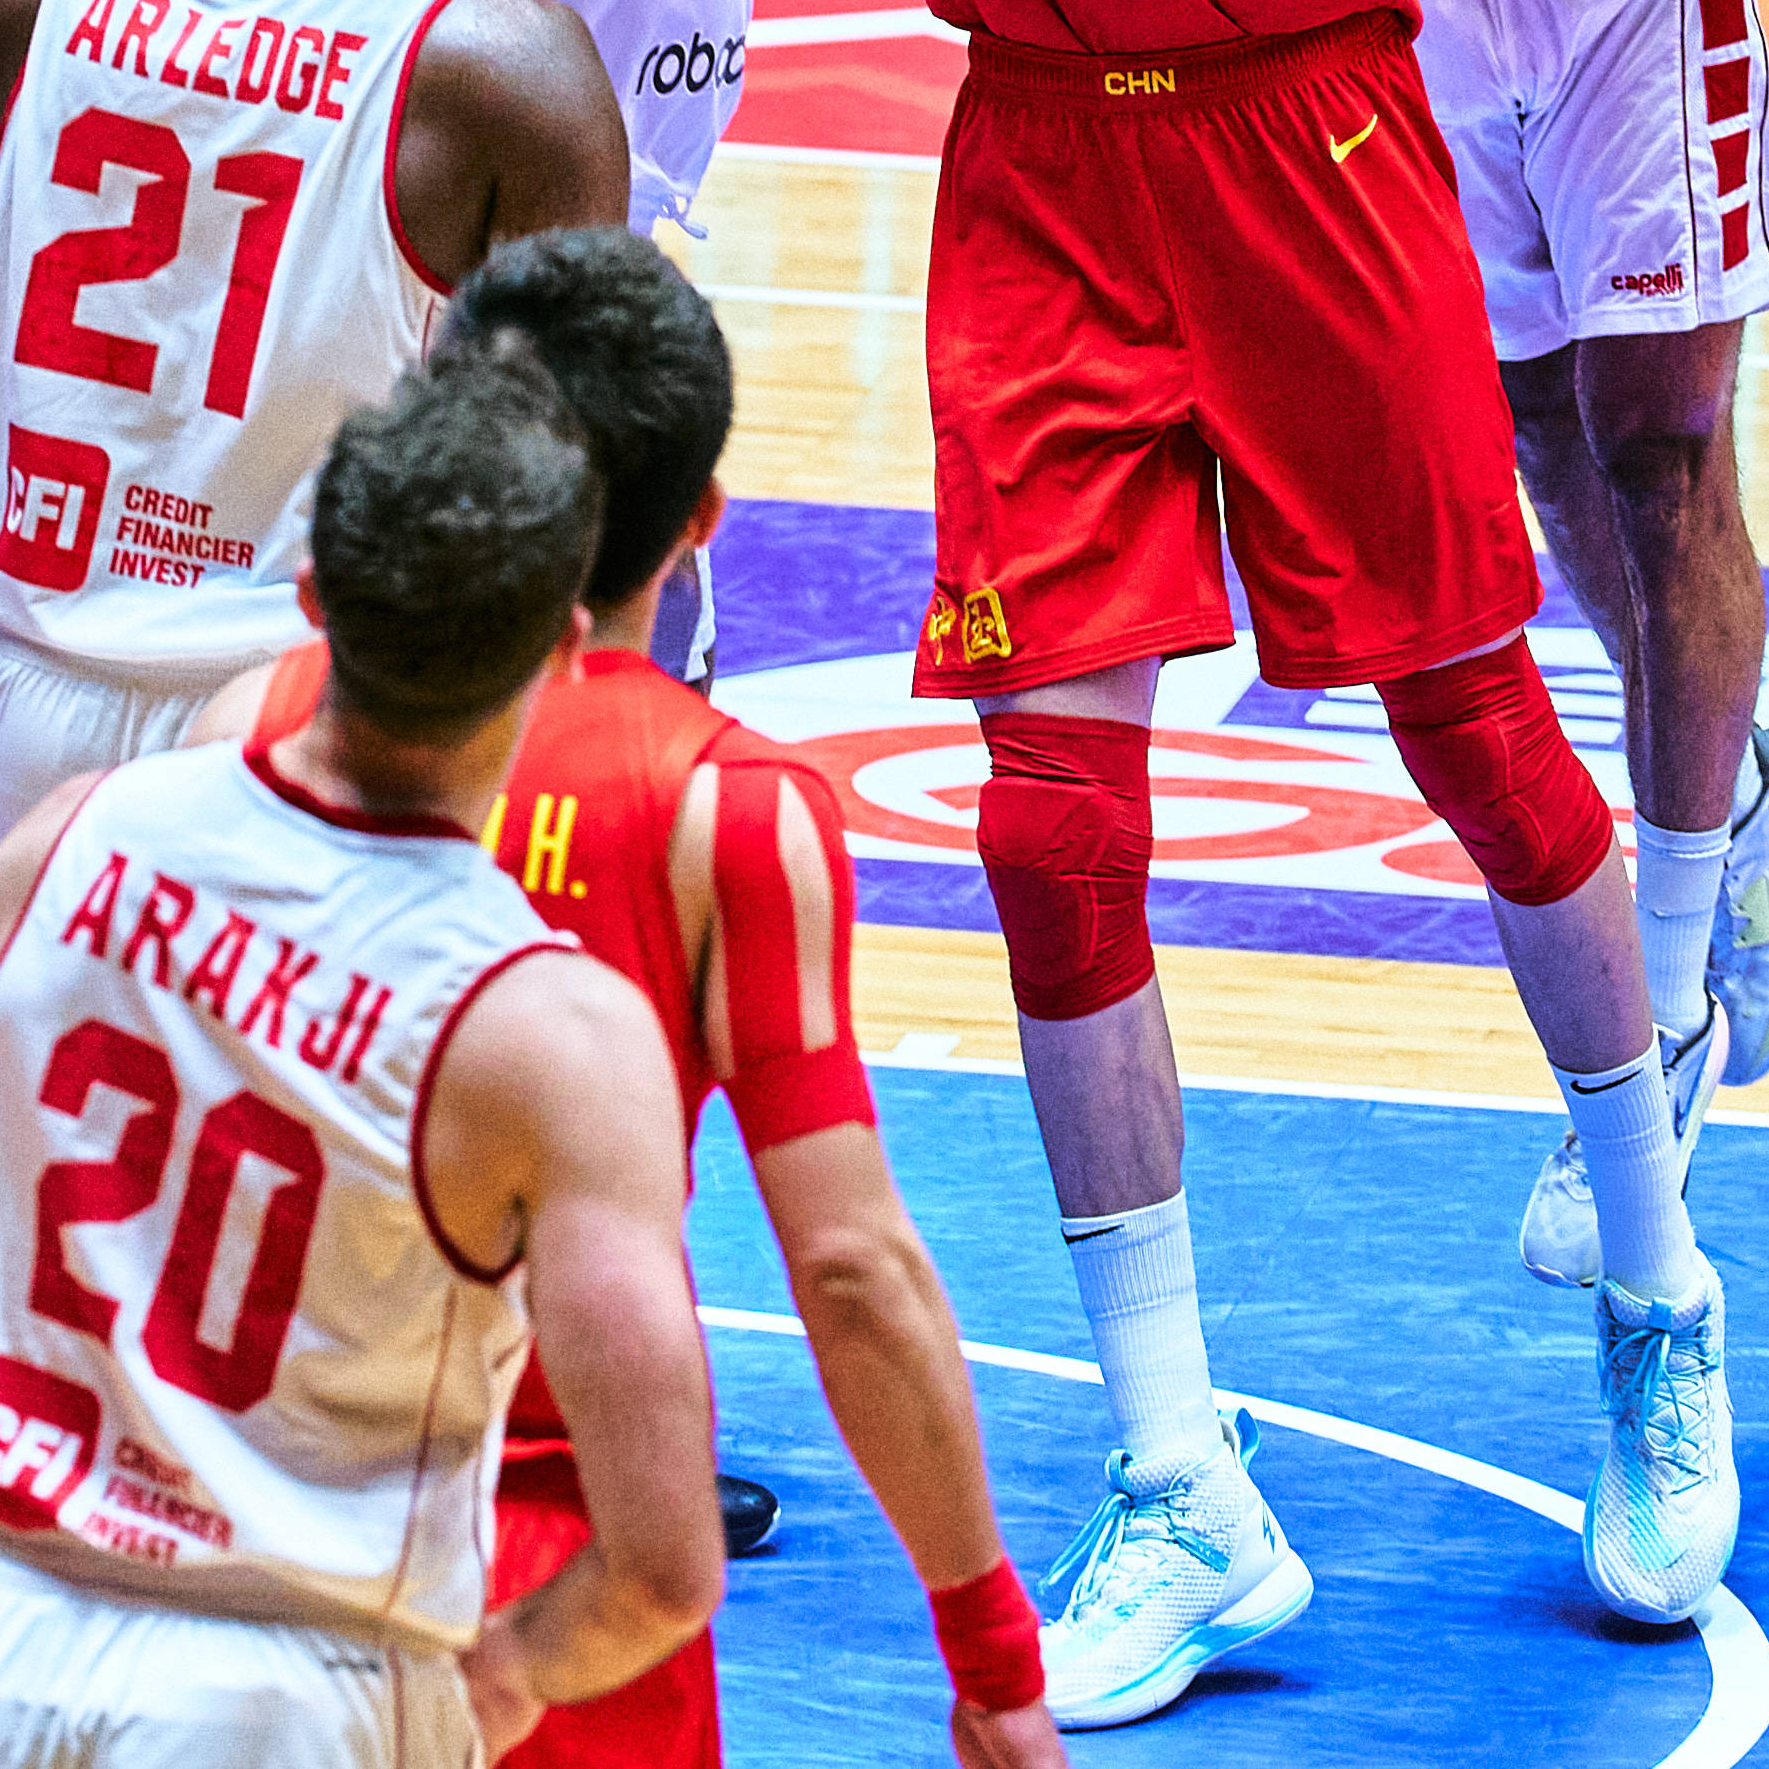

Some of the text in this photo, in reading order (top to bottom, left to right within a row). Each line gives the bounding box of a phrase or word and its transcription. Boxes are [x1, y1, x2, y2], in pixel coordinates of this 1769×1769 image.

[1103, 68, 1177, 97] CHN
[12, 106, 306, 422] 21
[1610, 262, 1685, 296] capelli
[6, 464, 86, 552] CFI
[124, 483, 214, 530] CREDIT
[108, 547, 206, 591] INVEST
[115, 515, 256, 571] FINANCIER
[60, 850, 394, 1086] ARAKJI
[29, 1016, 328, 1414] 20
